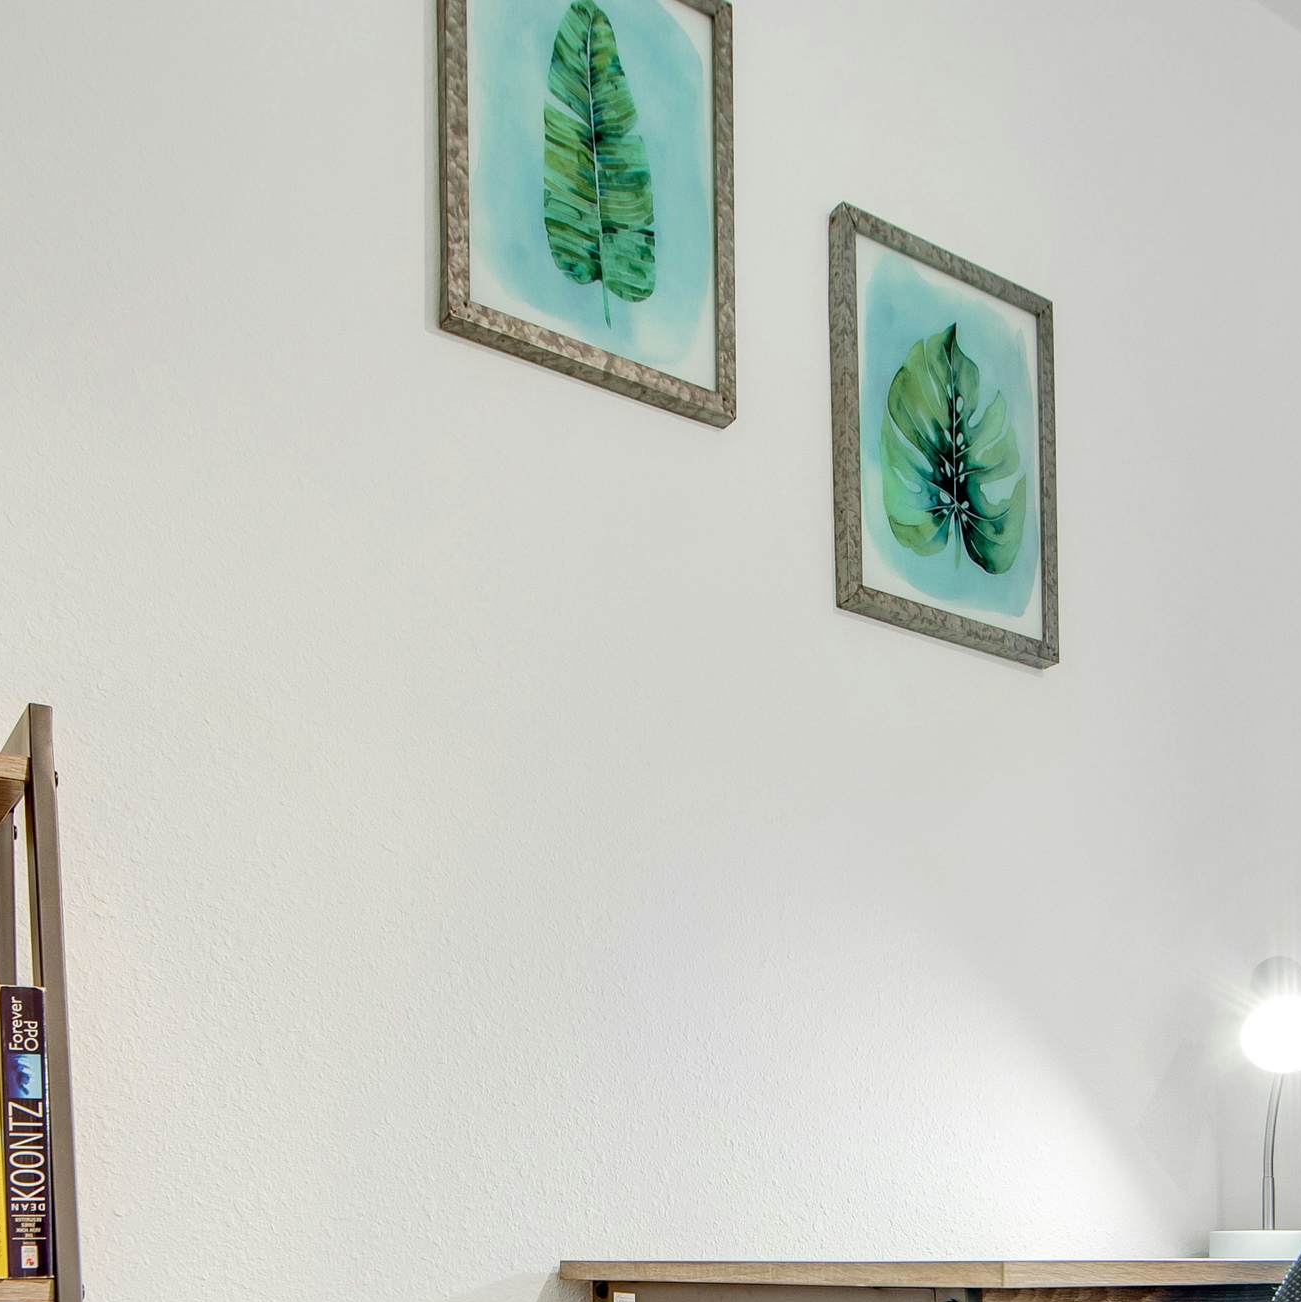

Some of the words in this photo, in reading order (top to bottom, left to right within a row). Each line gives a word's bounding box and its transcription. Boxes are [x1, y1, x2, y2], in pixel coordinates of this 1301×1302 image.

[9, 996, 24, 1051] Forever
[24, 1021, 39, 1052] Odd
[8, 1101, 46, 1202] KOONTZ
[11, 1202, 46, 1212] DEAN
